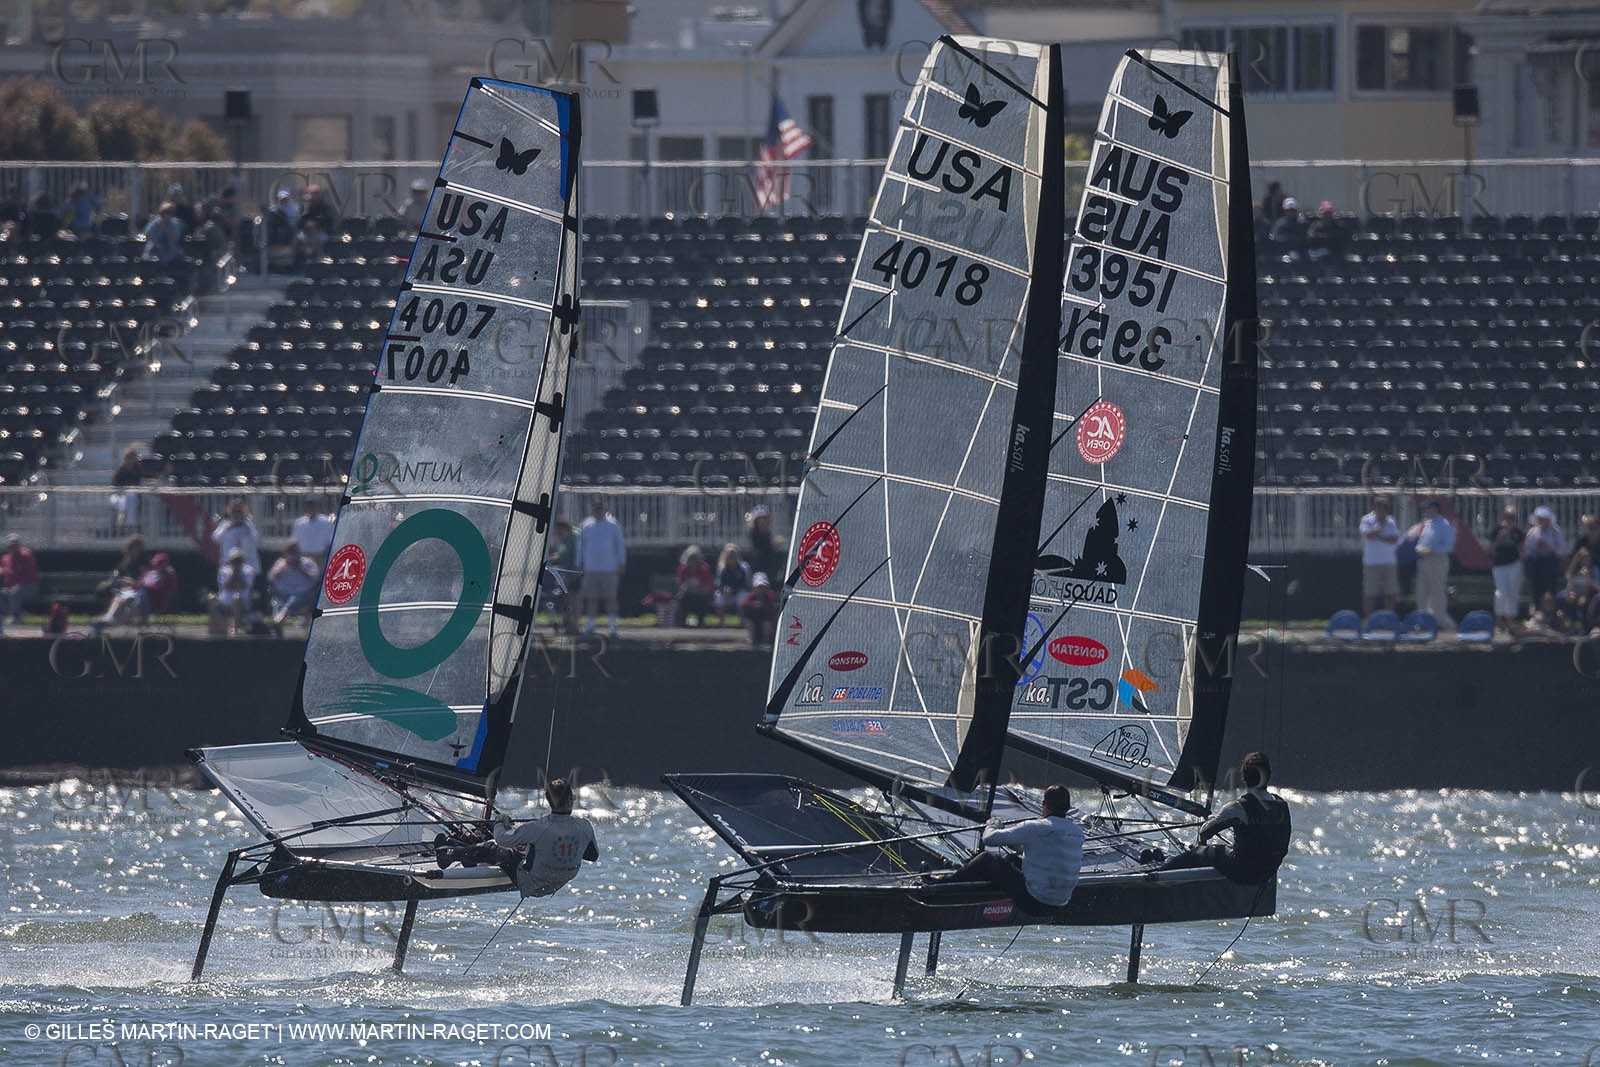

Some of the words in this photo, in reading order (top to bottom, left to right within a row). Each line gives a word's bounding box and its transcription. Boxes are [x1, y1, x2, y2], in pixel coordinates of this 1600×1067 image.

[907, 134, 1013, 213] USA
[1090, 147, 1190, 213] AUS
[437, 193, 509, 243] USA
[872, 239, 990, 306] 4018
[1071, 246, 1178, 314] 3951
[399, 295, 497, 339] 4007
[351, 453, 462, 494] QUANTUM
[829, 655, 868, 666] RONSTAN
